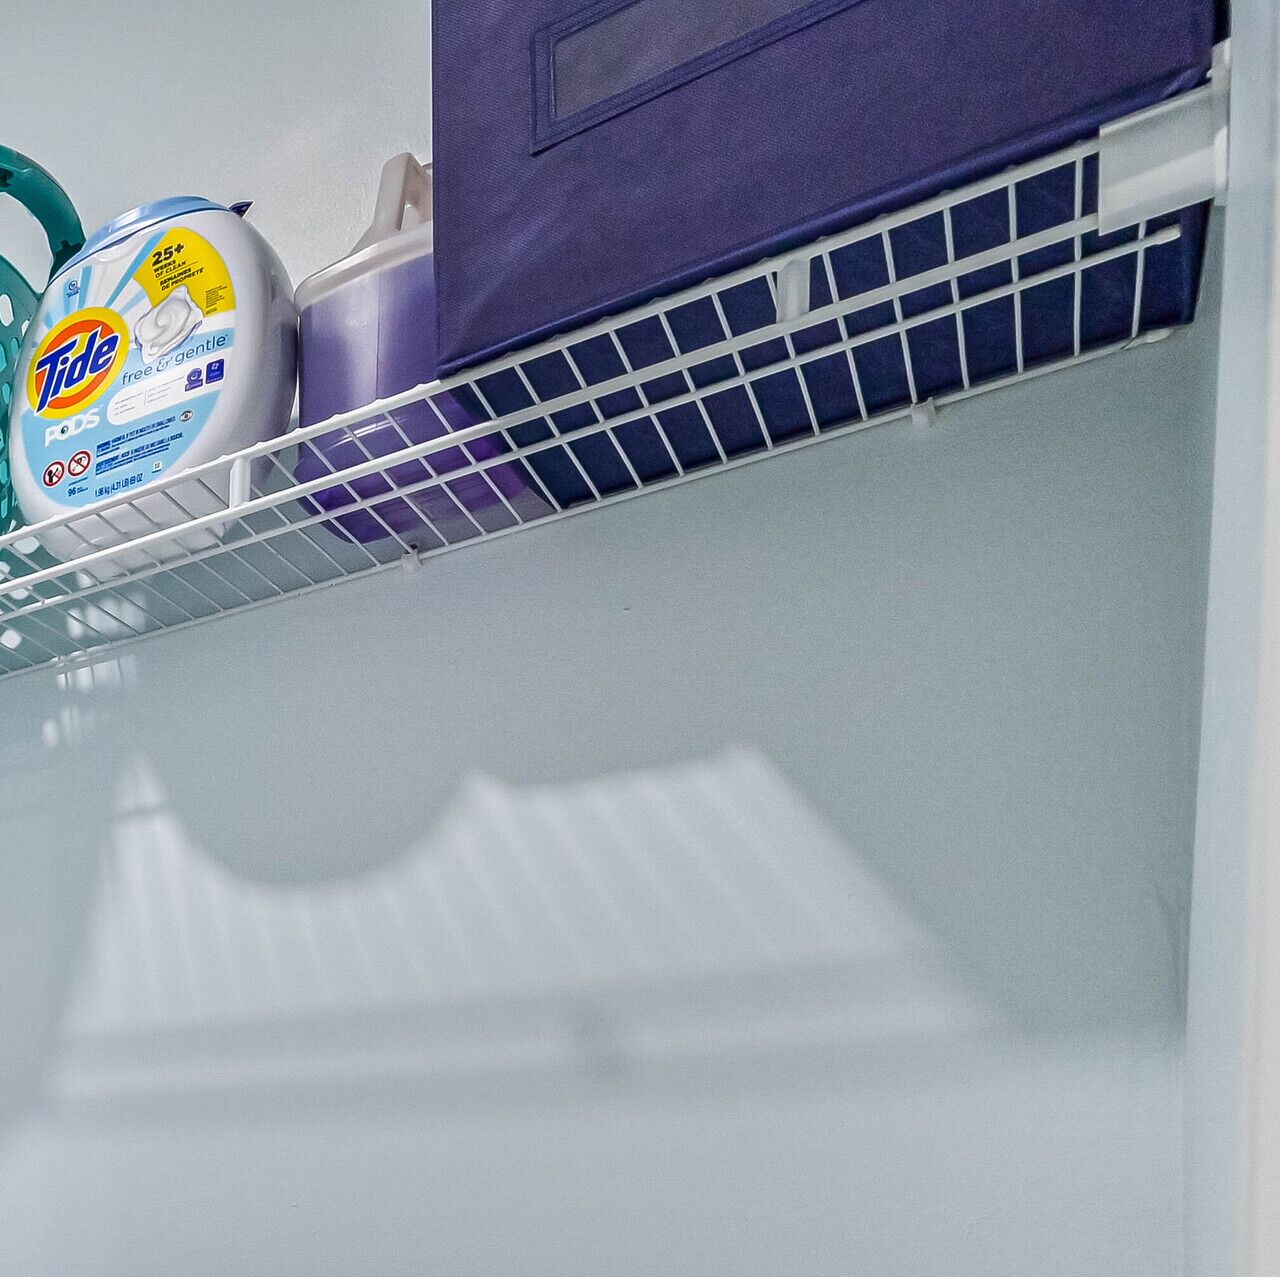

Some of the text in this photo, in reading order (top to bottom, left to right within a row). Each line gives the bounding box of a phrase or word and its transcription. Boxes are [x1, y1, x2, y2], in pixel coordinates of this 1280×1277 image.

[152, 243, 184, 267] 25+
[35, 326, 120, 416] Tide
[122, 335, 226, 385] free & gentle
[44, 407, 100, 447] PODS
